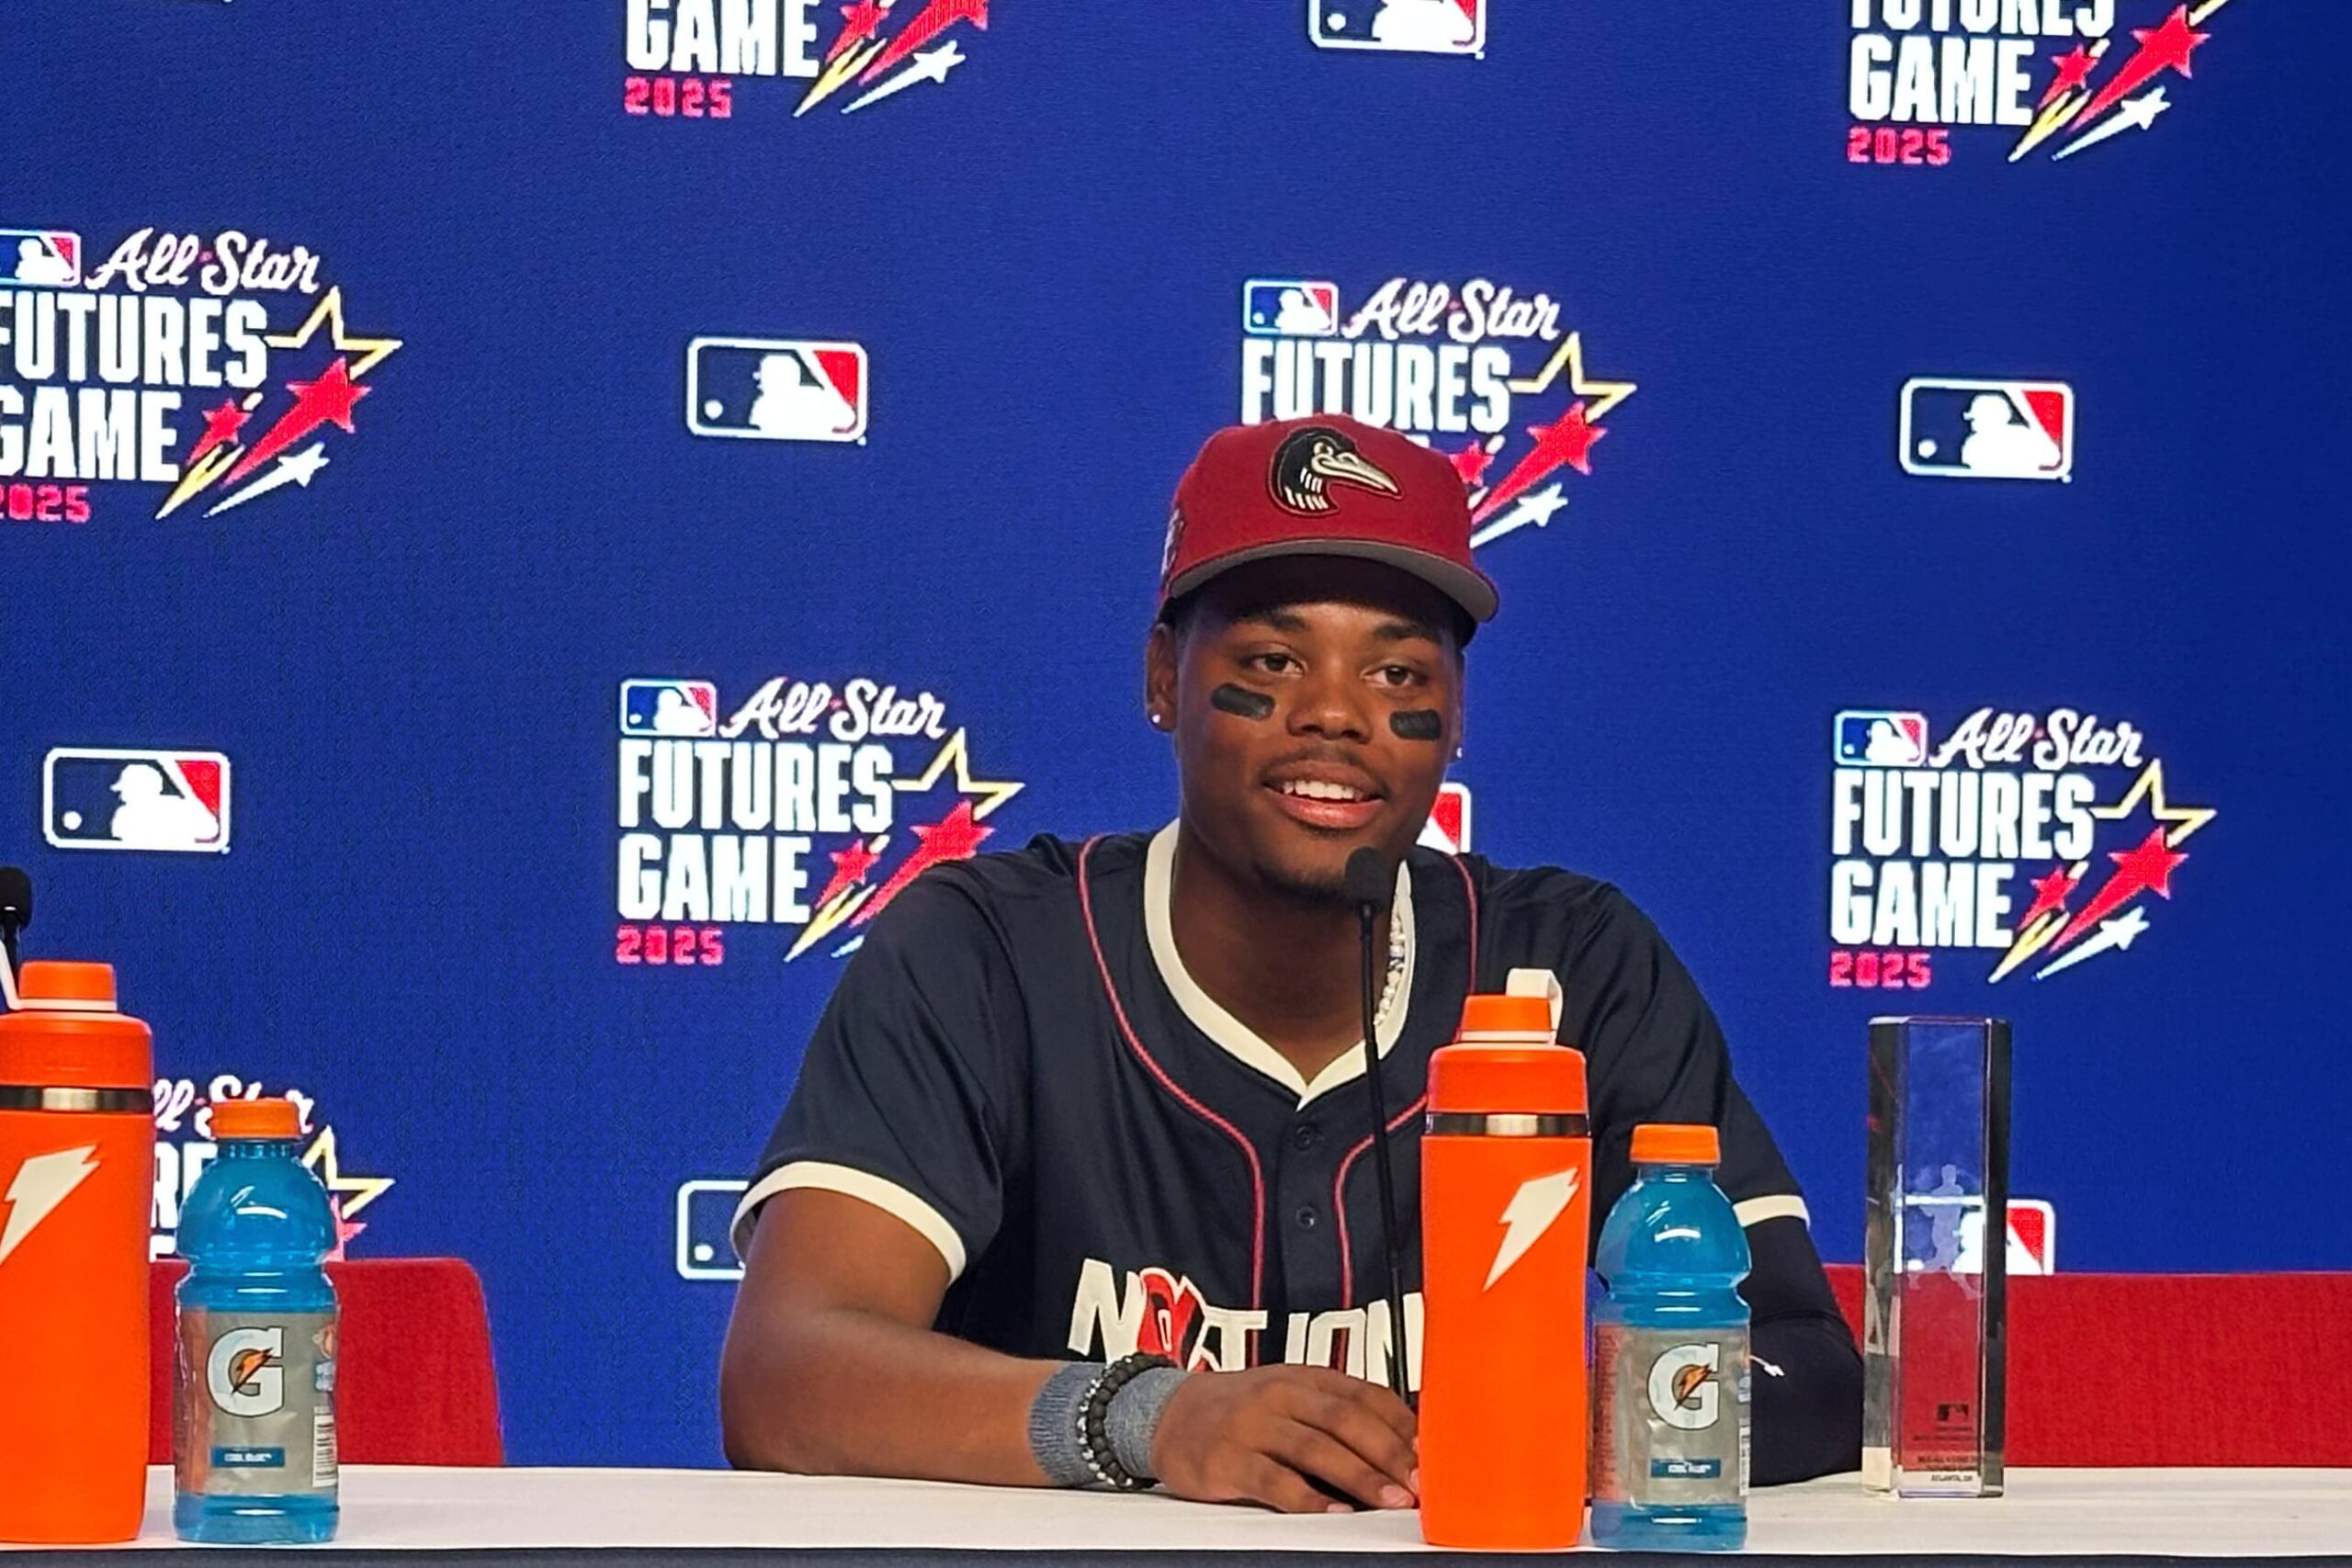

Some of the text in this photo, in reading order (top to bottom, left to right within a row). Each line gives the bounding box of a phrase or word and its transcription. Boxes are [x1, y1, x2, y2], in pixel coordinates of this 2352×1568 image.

[626, 0, 820, 77] GAME
[1849, 33, 2034, 125] GAME
[624, 76, 732, 118] 2025
[1847, 127, 1951, 165] 2025
[1242, 338, 1510, 433] FUTURES
[0, 483, 91, 523] 025
[618, 739, 893, 833] FUTURES
[1832, 768, 2095, 860] FUTURES
[617, 833, 811, 923] GAME
[1831, 860, 2014, 947] GAME
[616, 925, 725, 965] 2025
[1830, 951, 1932, 989] 2025
[207, 1325, 285, 1417] G
[1646, 1342, 1720, 1430] G
